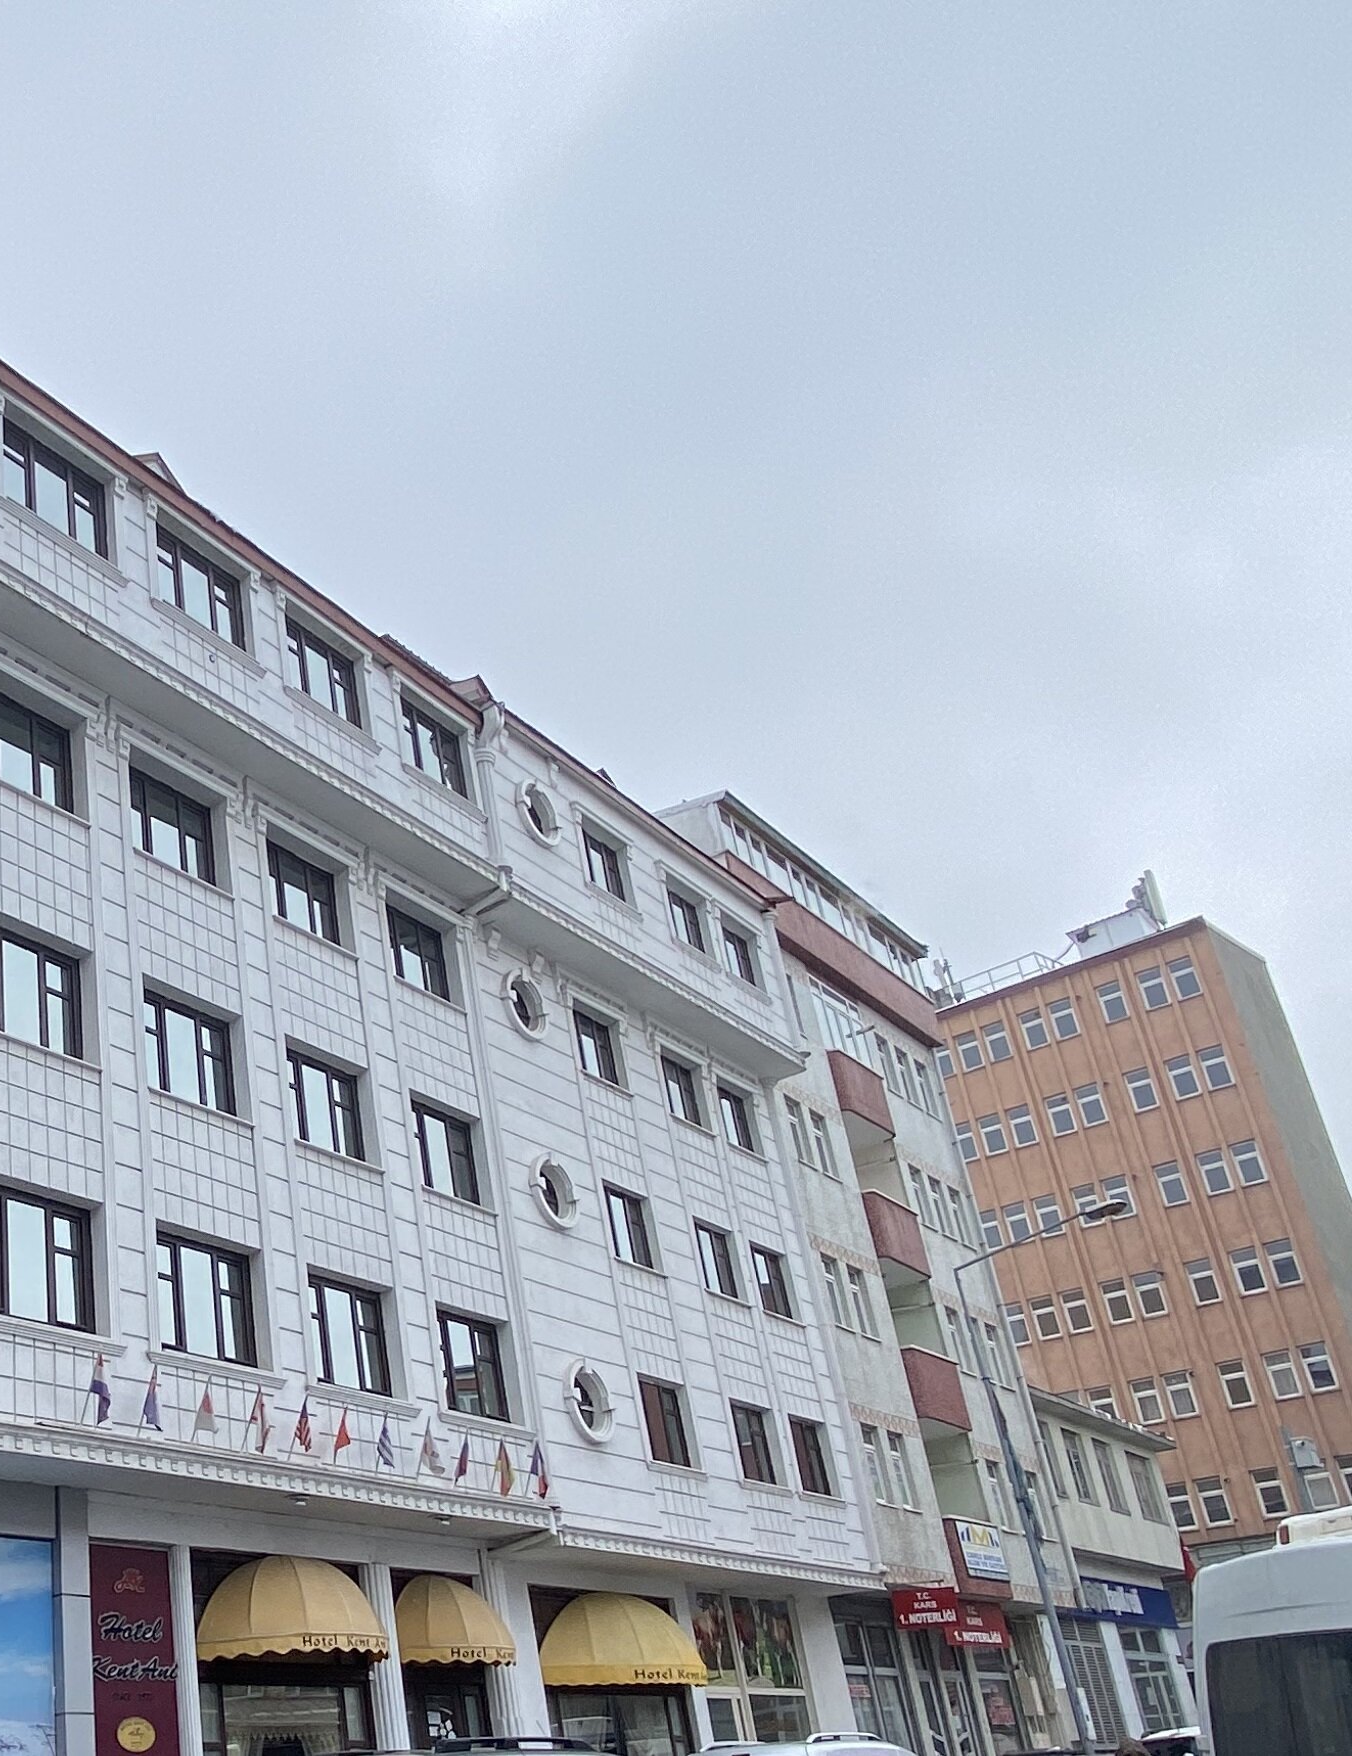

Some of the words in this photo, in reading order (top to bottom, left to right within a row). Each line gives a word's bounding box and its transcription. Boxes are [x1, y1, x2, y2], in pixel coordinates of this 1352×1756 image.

[913, 1600, 938, 1610] KARS
[98, 1612, 164, 1643] Hotel
[302, 1633, 338, 1647] Hotel
[347, 1635, 370, 1647] Kent
[451, 1646, 487, 1658] Hotel
[634, 1668, 673, 1680] Hotel
